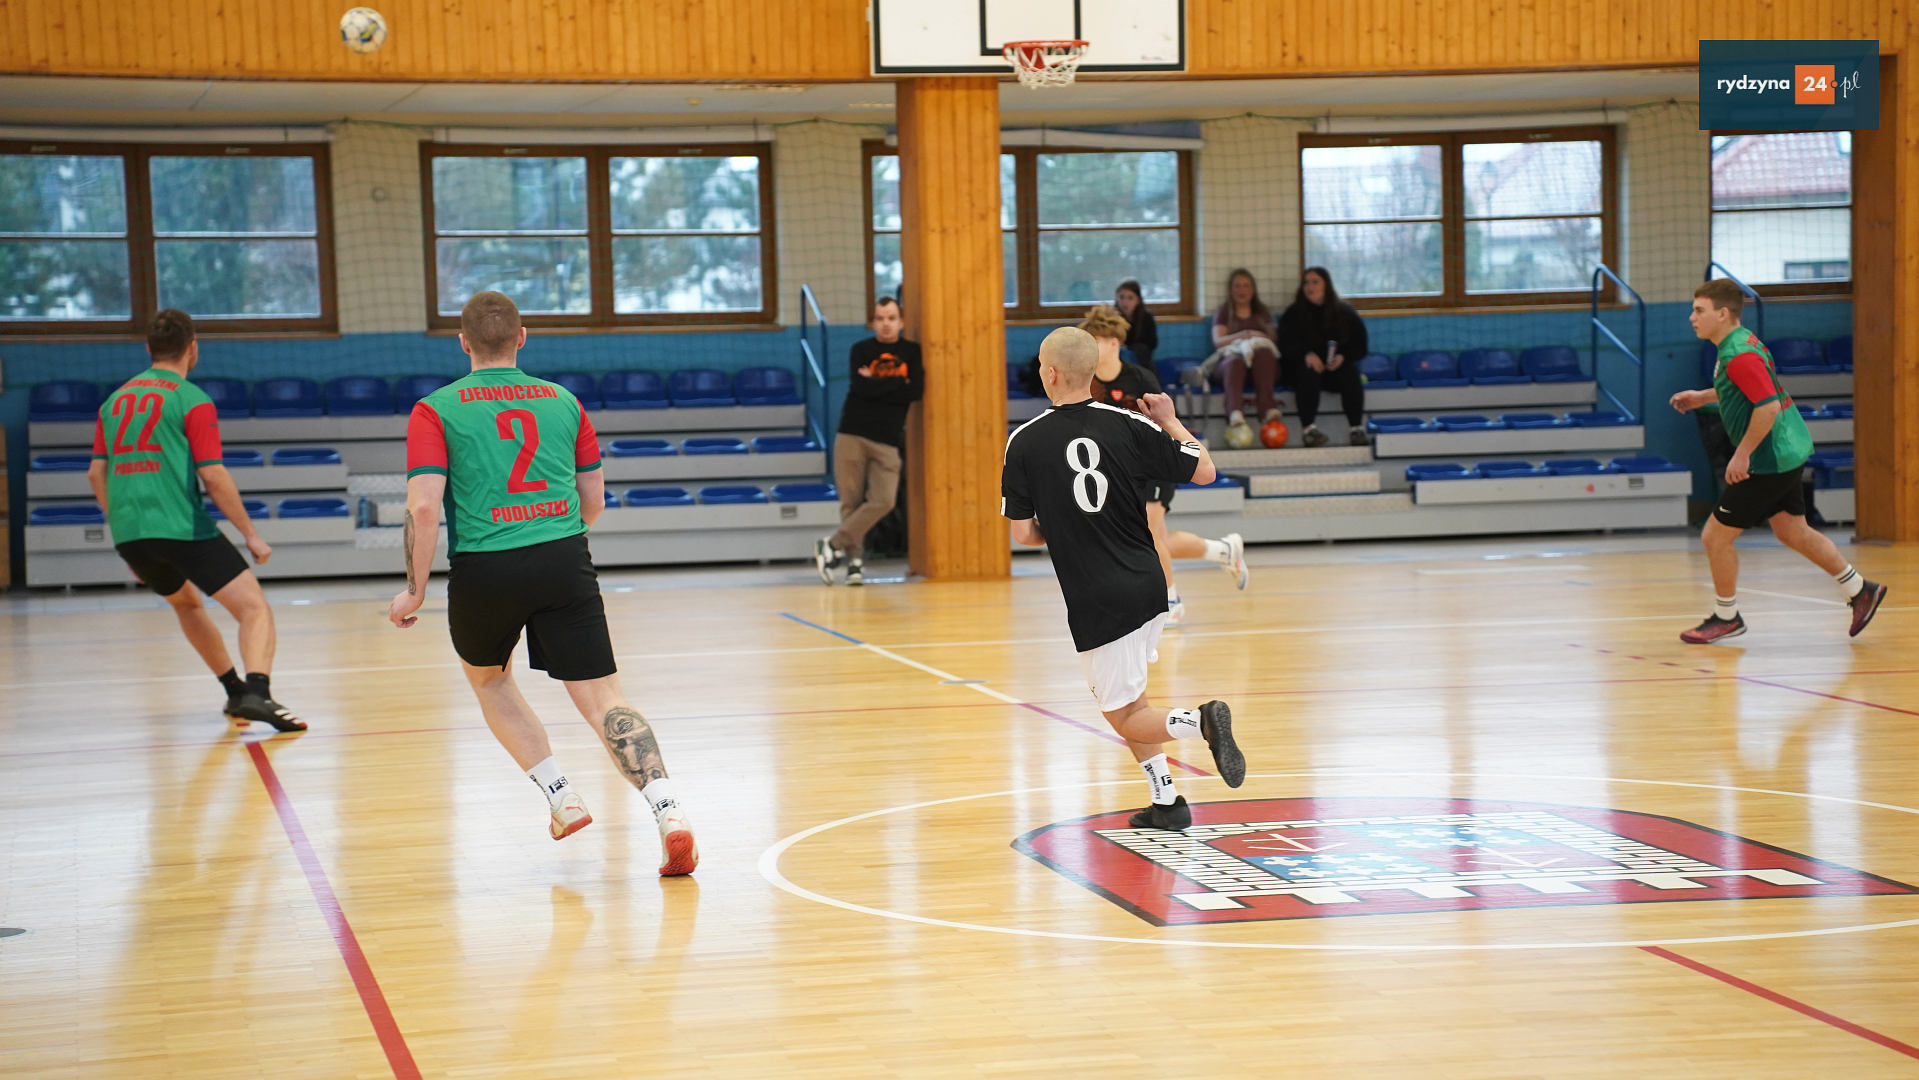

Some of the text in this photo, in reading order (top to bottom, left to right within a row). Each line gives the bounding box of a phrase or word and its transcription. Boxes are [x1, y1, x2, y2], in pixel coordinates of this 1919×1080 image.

[111, 392, 165, 455] 22
[456, 384, 558, 403] ZJEDNOCZENI
[495, 408, 548, 494] 2
[1066, 437, 1109, 513] 8
[490, 499, 569, 523] PUDLISZKI
